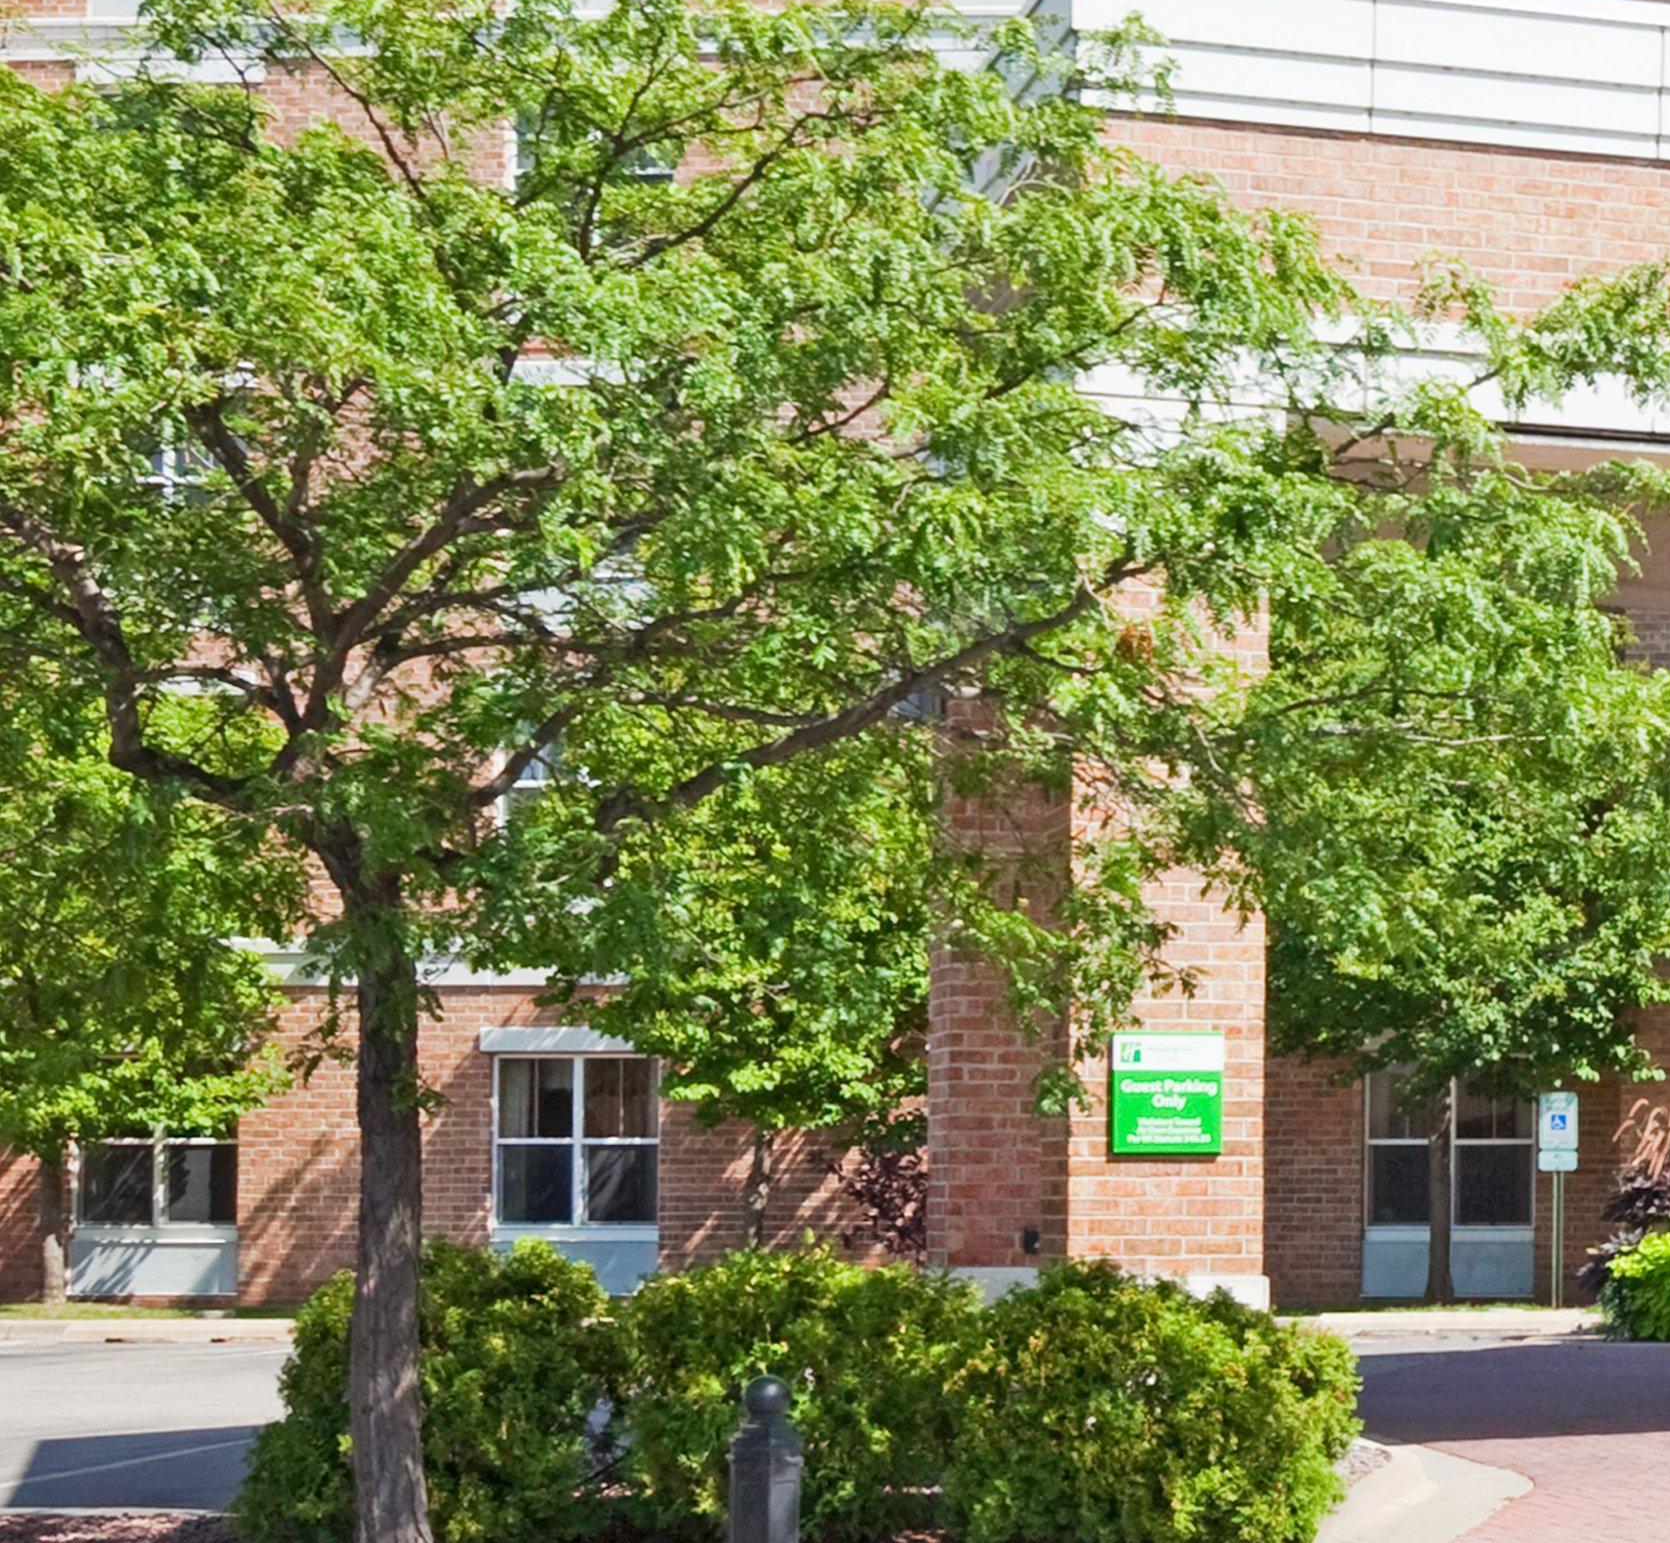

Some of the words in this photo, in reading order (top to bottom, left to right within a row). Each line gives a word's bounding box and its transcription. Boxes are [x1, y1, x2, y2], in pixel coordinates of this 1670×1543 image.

[1120, 1079, 1162, 1093] Guest
[1164, 1079, 1217, 1096] Parking
[1152, 1094, 1186, 1110] Only
